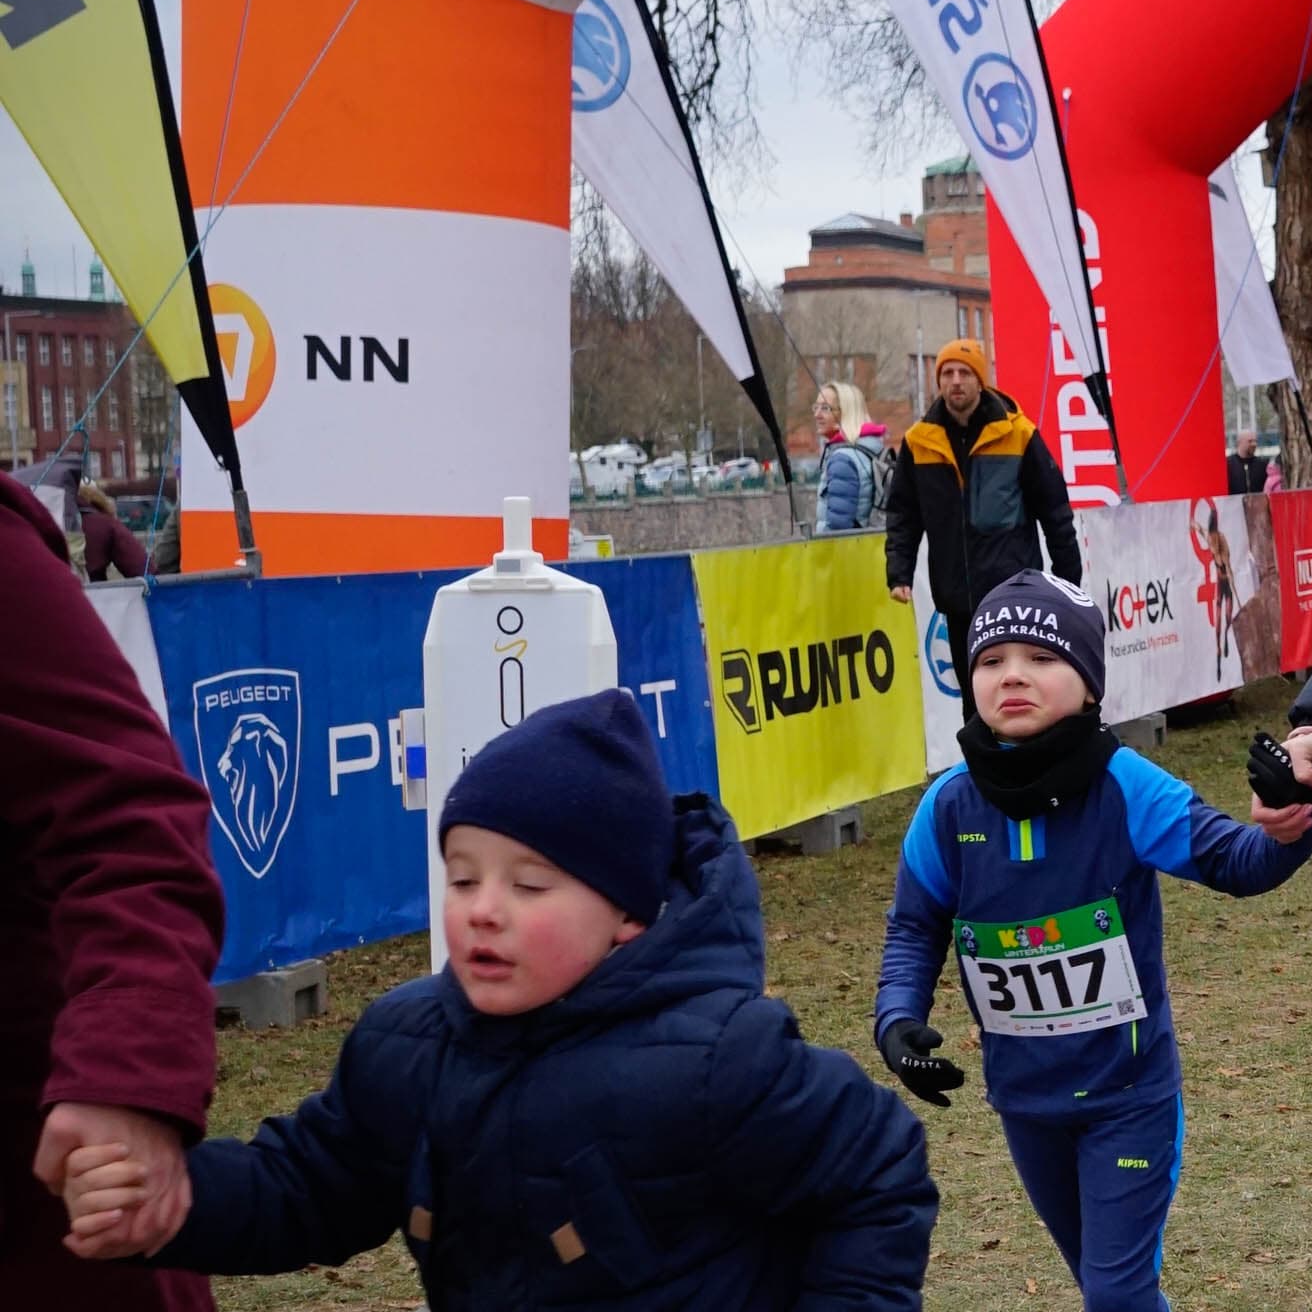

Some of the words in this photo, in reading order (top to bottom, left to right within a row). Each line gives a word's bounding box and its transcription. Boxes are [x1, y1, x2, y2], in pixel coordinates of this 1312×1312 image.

[304, 335, 410, 383] NN
[1106, 577, 1174, 632] kotex
[975, 606, 1058, 632] SLAVIA
[1010, 624, 1071, 652] KRÁLOVÉ
[757, 629, 895, 721] RUNTO
[205, 685, 292, 713] PEUGEOT
[977, 947, 1107, 1013] 3117
[900, 1055, 941, 1069] KIPSTA
[1116, 1158, 1149, 1168] KIPSTA
